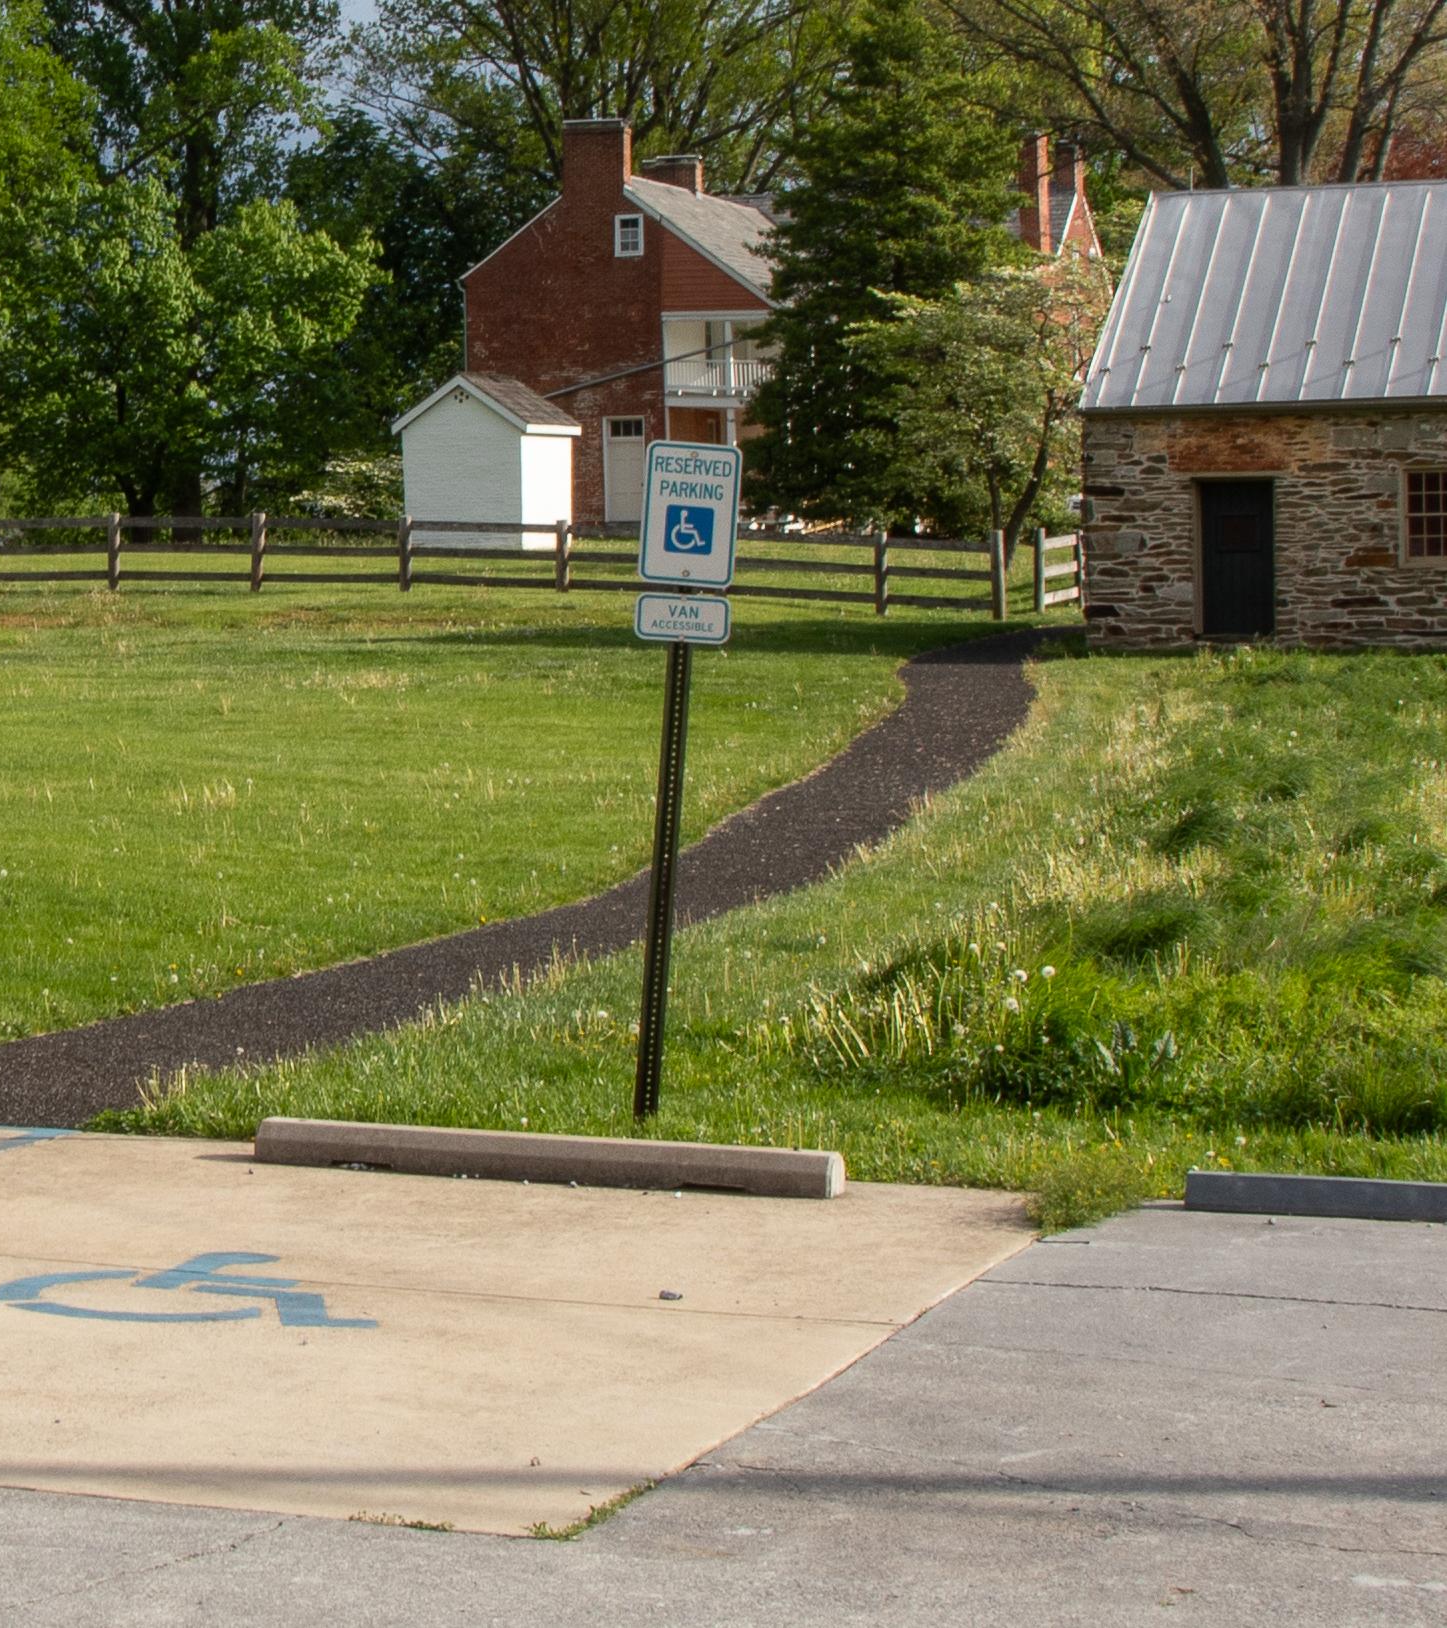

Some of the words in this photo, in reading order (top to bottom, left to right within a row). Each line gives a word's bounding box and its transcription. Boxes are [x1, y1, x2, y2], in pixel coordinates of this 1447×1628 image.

[654, 456, 732, 478] RESERVED
[659, 480, 724, 501] PARKING
[668, 604, 699, 619] VAN
[651, 619, 714, 632] ACCESSIBLE
